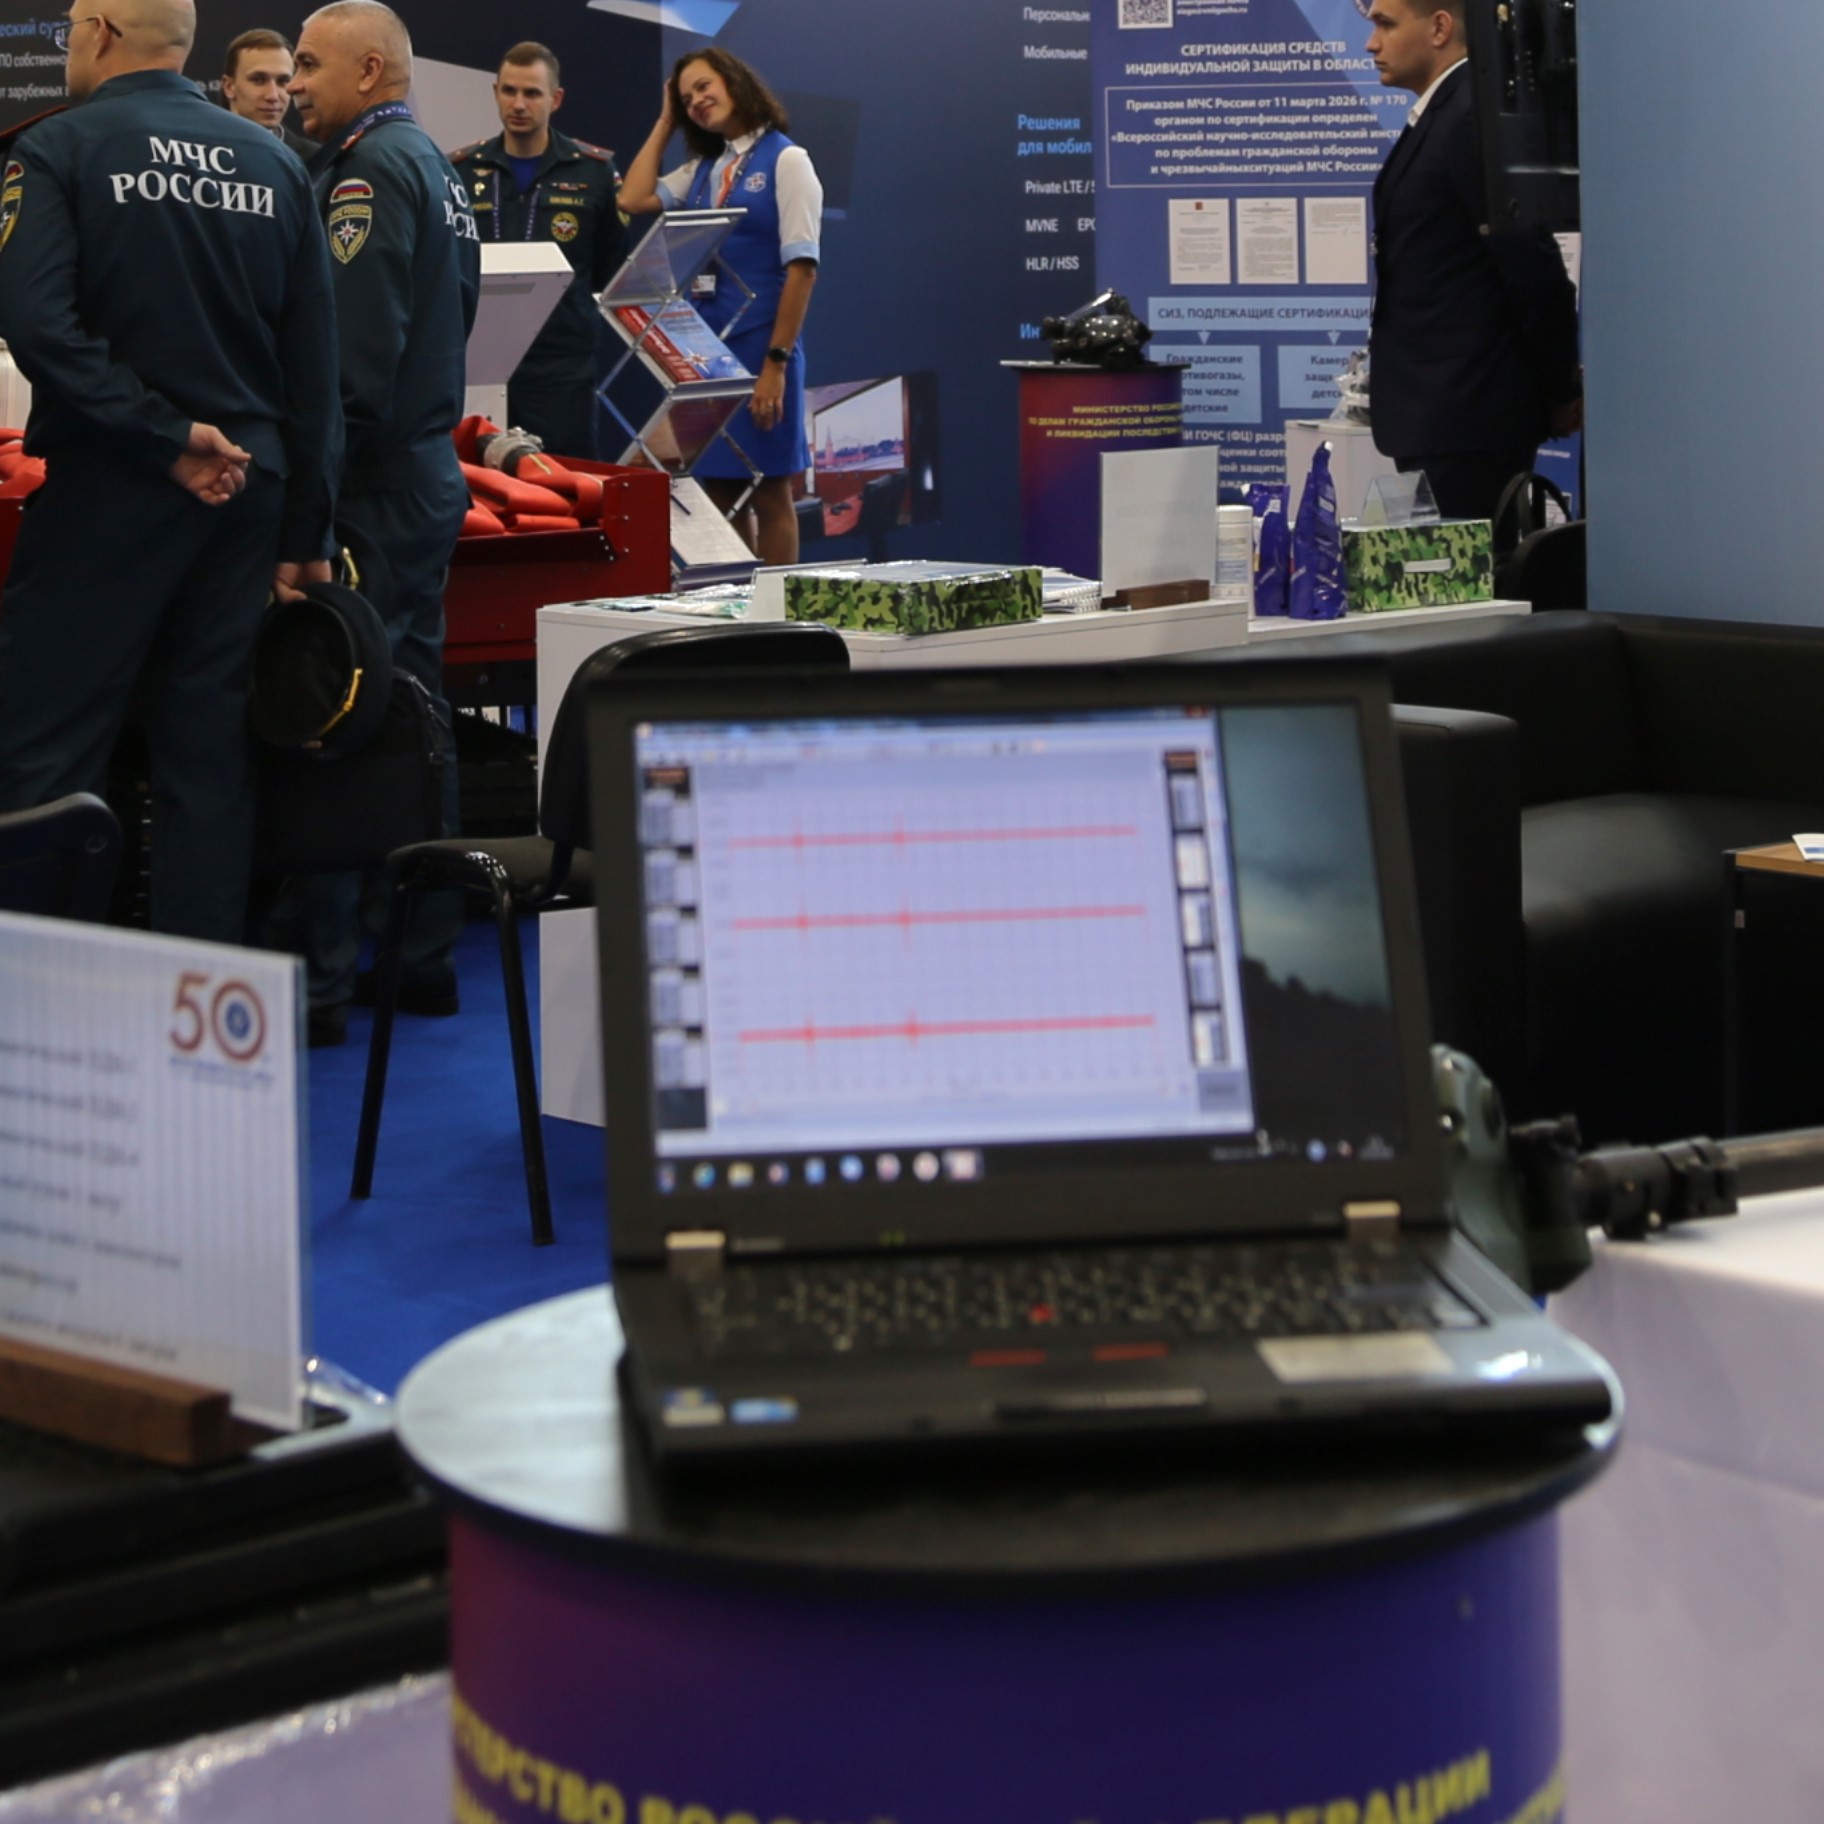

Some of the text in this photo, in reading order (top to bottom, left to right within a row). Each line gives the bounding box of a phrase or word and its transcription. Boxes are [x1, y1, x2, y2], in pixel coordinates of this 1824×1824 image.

[1024, 45, 1087, 60] Мобильные
[1181, 41, 1346, 57] СЕРТИФИКАЦИЯ СРЕДСТВ
[1126, 58, 1322, 75] ИНДИВИДУАЛЬНОЙ ЗАЩИТЫ В
[8, 84, 63, 101] зарубежных
[1126, 98, 1185, 112] Приказом
[1186, 96, 1213, 109] МЧС
[1214, 96, 1255, 109] России
[1257, 98, 1271, 108] от
[1273, 96, 1288, 107] 11
[1290, 97, 1326, 109] марта
[1018, 114, 1081, 130] Решения
[1154, 111, 1378, 127] органом по сертификации определен
[1111, 127, 1368, 144] «Всероссийский научно-исследовательский
[148, 136, 237, 175] МЧС
[1017, 142, 1044, 156] для
[1155, 144, 1378, 160] по проблемам гражданской обороны
[1150, 164, 1159, 175] и
[1306, 161, 1334, 173] МЧС
[109, 170, 276, 218] РОССИИ
[1025, 180, 1083, 194] Private LTE
[1026, 218, 1059, 232] MVNE
[1187, 306, 1274, 321] ПОДЛЕЖАЩИЕ
[1195, 430, 1225, 442] ГОЧС
